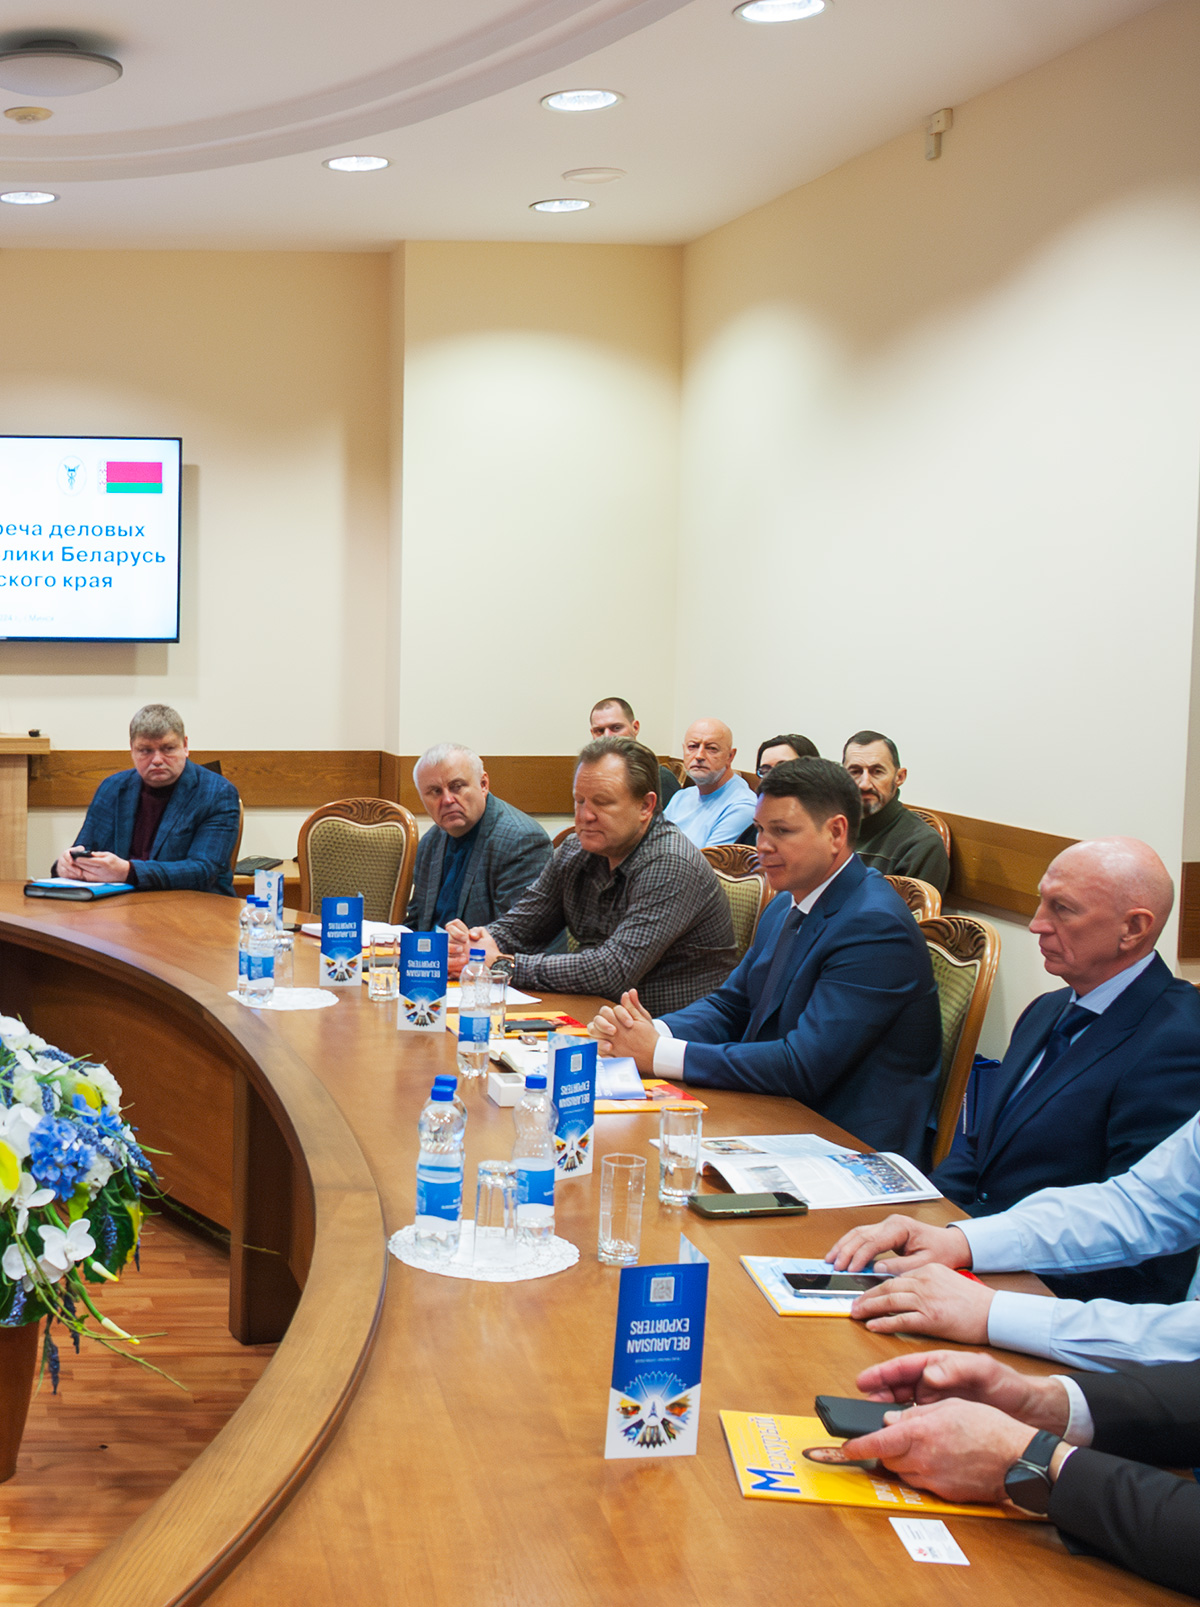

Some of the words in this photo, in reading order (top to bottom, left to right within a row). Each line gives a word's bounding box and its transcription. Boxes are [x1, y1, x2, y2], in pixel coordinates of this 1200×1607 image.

[48, 523, 145, 539] деловых
[61, 545, 166, 567] Беларусь
[63, 575, 113, 592] края
[629, 1317, 690, 1336] EXPORTERS
[626, 1336, 691, 1354] BELARUSIAN
